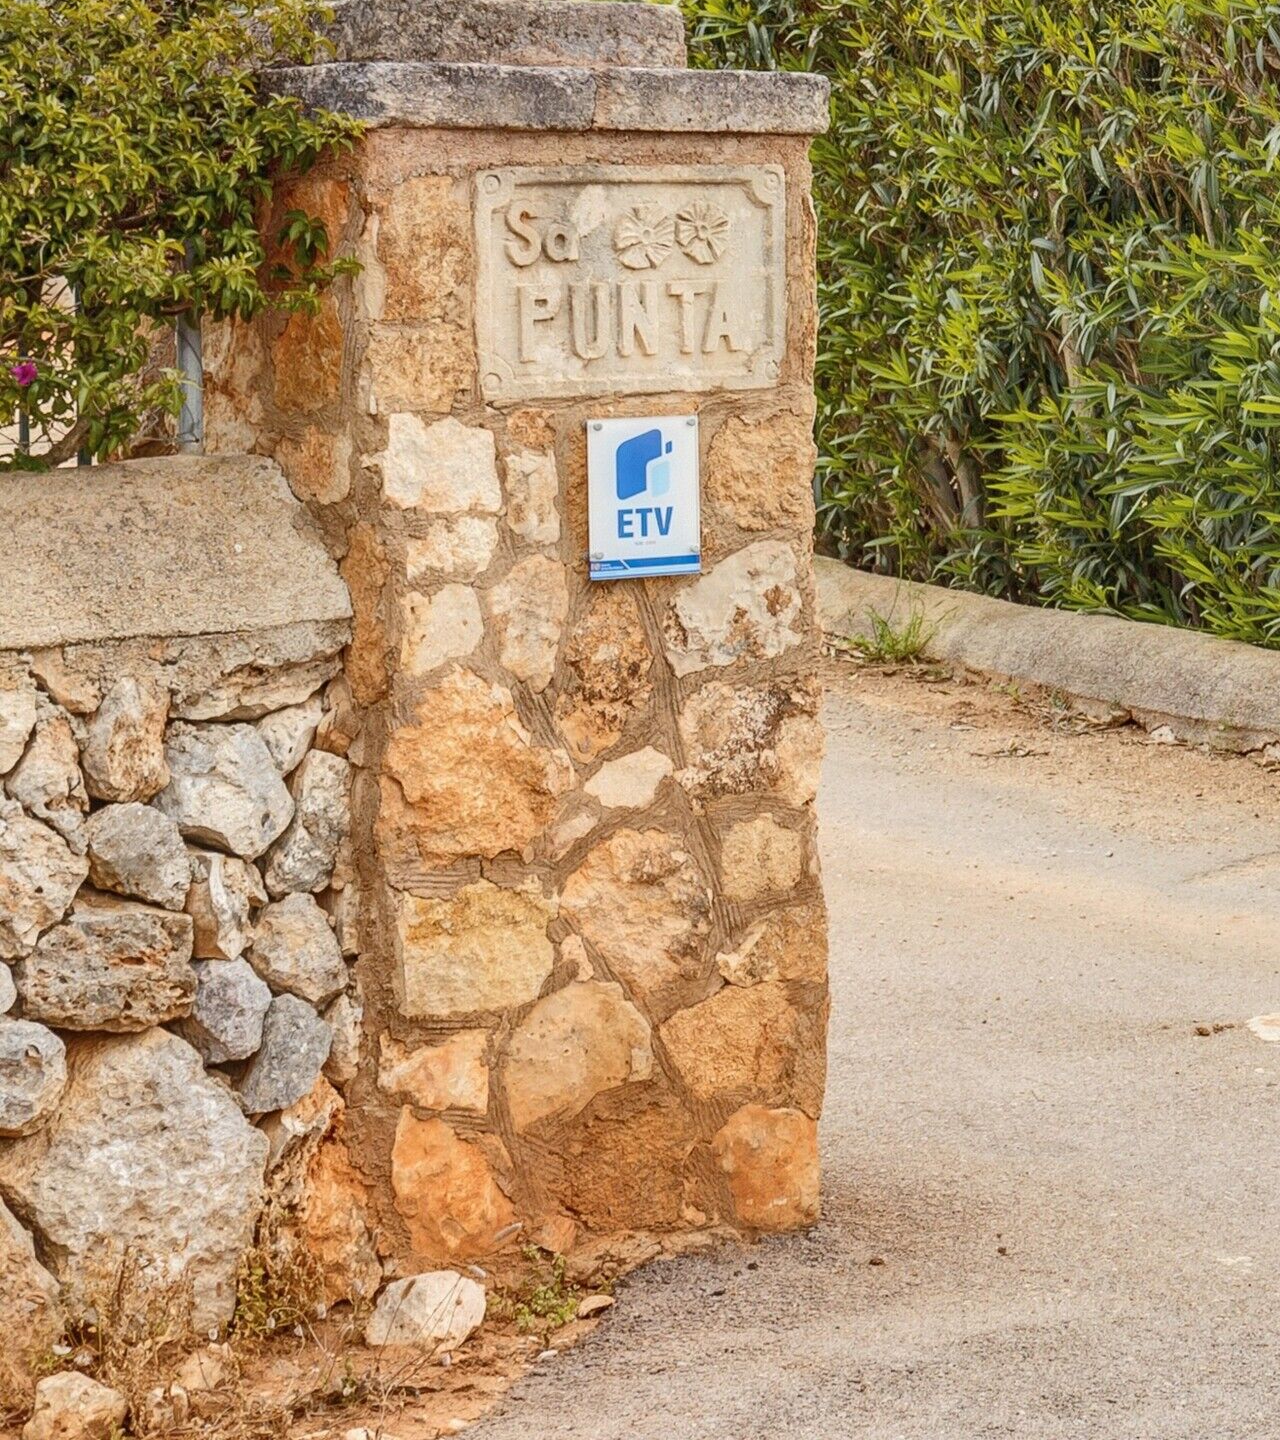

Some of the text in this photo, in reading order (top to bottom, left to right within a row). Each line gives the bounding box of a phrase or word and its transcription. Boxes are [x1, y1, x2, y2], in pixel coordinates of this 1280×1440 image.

[504, 200, 579, 268] Sa
[516, 279, 747, 363] PUNTA
[617, 506, 674, 538] ETV
